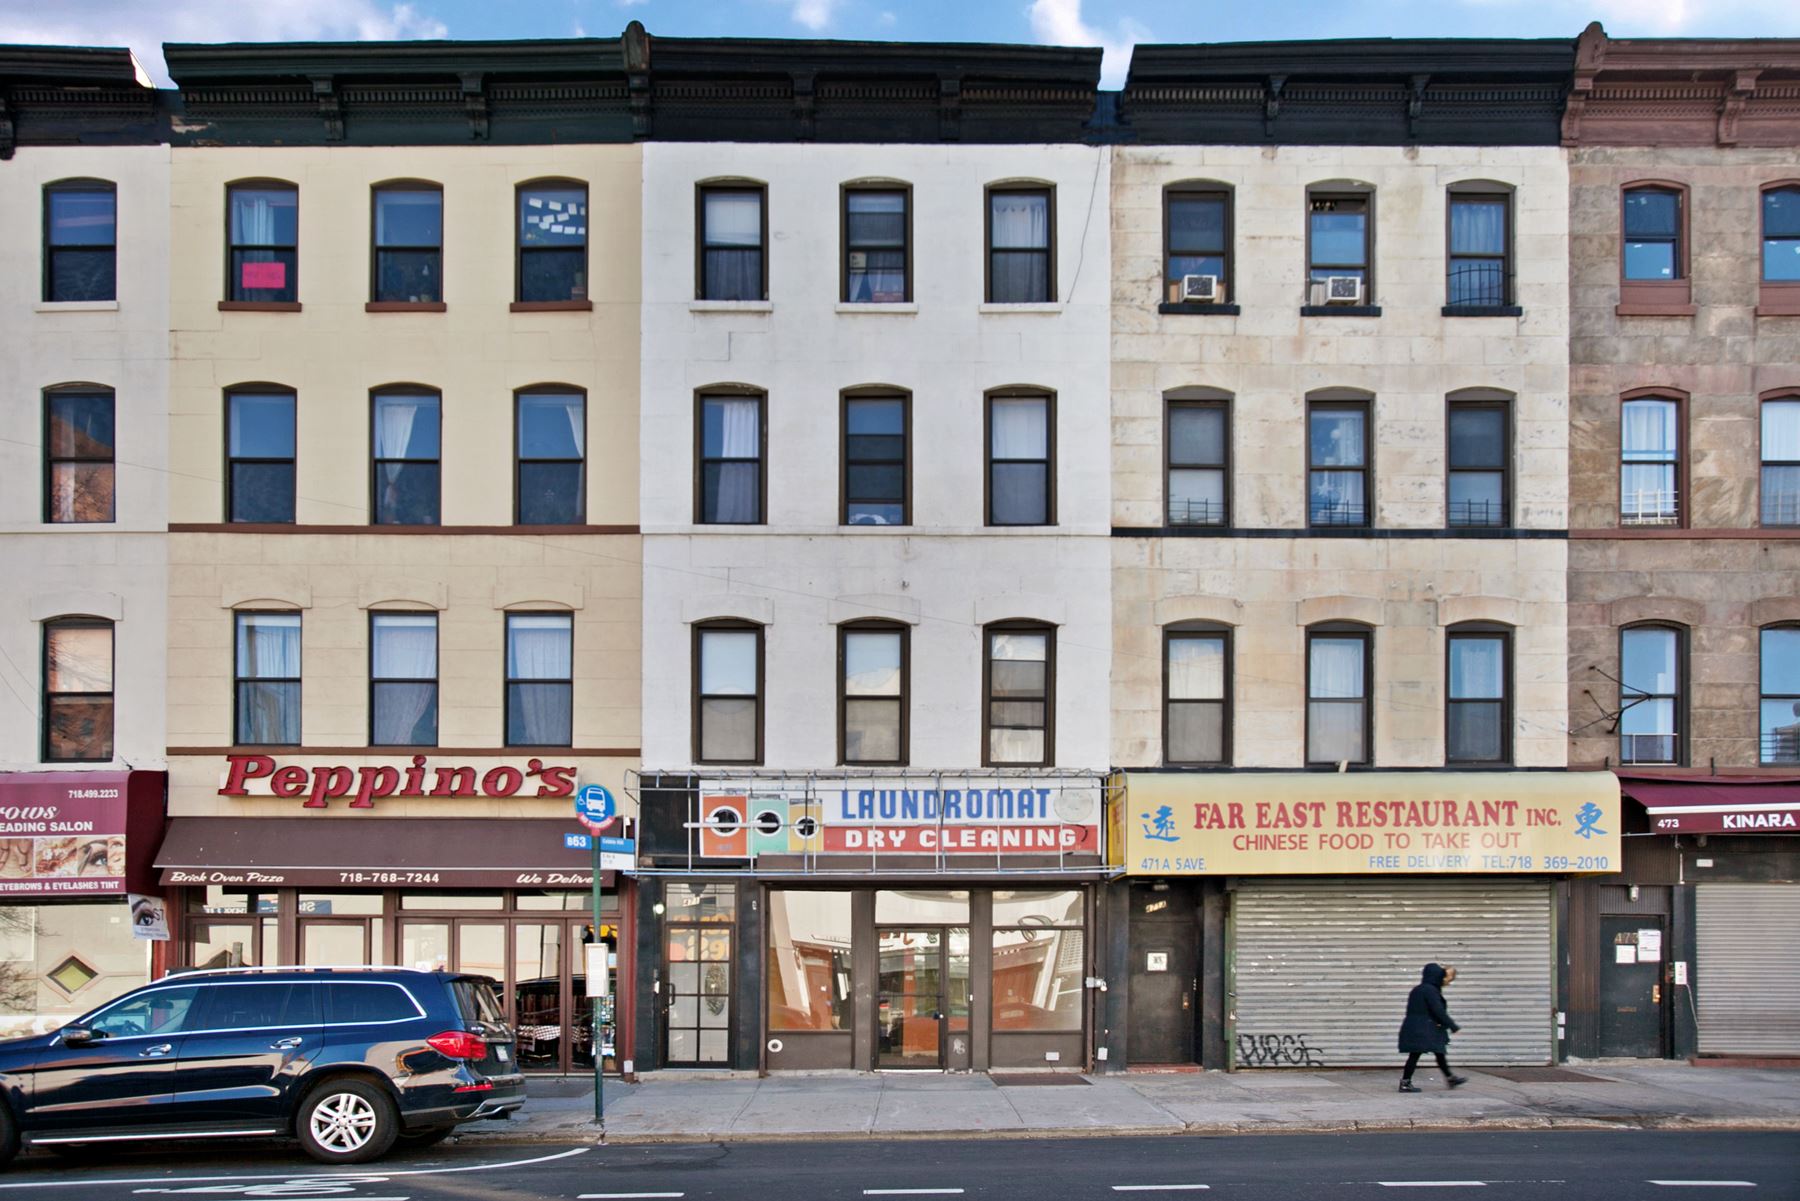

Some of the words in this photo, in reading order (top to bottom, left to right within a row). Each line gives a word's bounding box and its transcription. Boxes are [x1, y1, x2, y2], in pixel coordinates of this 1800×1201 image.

[218, 754, 577, 809] Peppino's
[68, 789, 119, 799] 718.499.2233
[841, 788, 1051, 819] LAUNDROMAT
[1193, 802, 1247, 829] FAR
[1255, 802, 1326, 829] EAST
[1336, 800, 1519, 828] RESTAURANT
[1526, 808, 1562, 827] INC.
[1722, 813, 1797, 829] KINARA
[50, 821, 94, 832] SALON
[1657, 819, 1680, 828] 473
[567, 835, 587, 848] B63
[845, 829, 907, 848] DRY
[918, 828, 1077, 848] CLEANING
[1232, 833, 1309, 851] CHINESE
[1319, 833, 1374, 850] FOOD
[1384, 832, 1411, 850] TO
[1421, 832, 1471, 849] TAKE
[1481, 831, 1522, 849] OUT
[1369, 856, 1401, 868] FREE
[1407, 856, 1472, 868] DELIVERY
[1543, 856, 1609, 869] 369-2010
[170, 871, 207, 883] Brick
[209, 871, 244, 883] Oven
[246, 872, 285, 883] Pizza
[339, 872, 440, 883] 718-768-7244
[516, 873, 543, 884] We
[546, 873, 603, 884] Delive
[44, 882, 51, 890] &
[53, 881, 99, 891] EYELASHES
[100, 881, 120, 890] TINT
